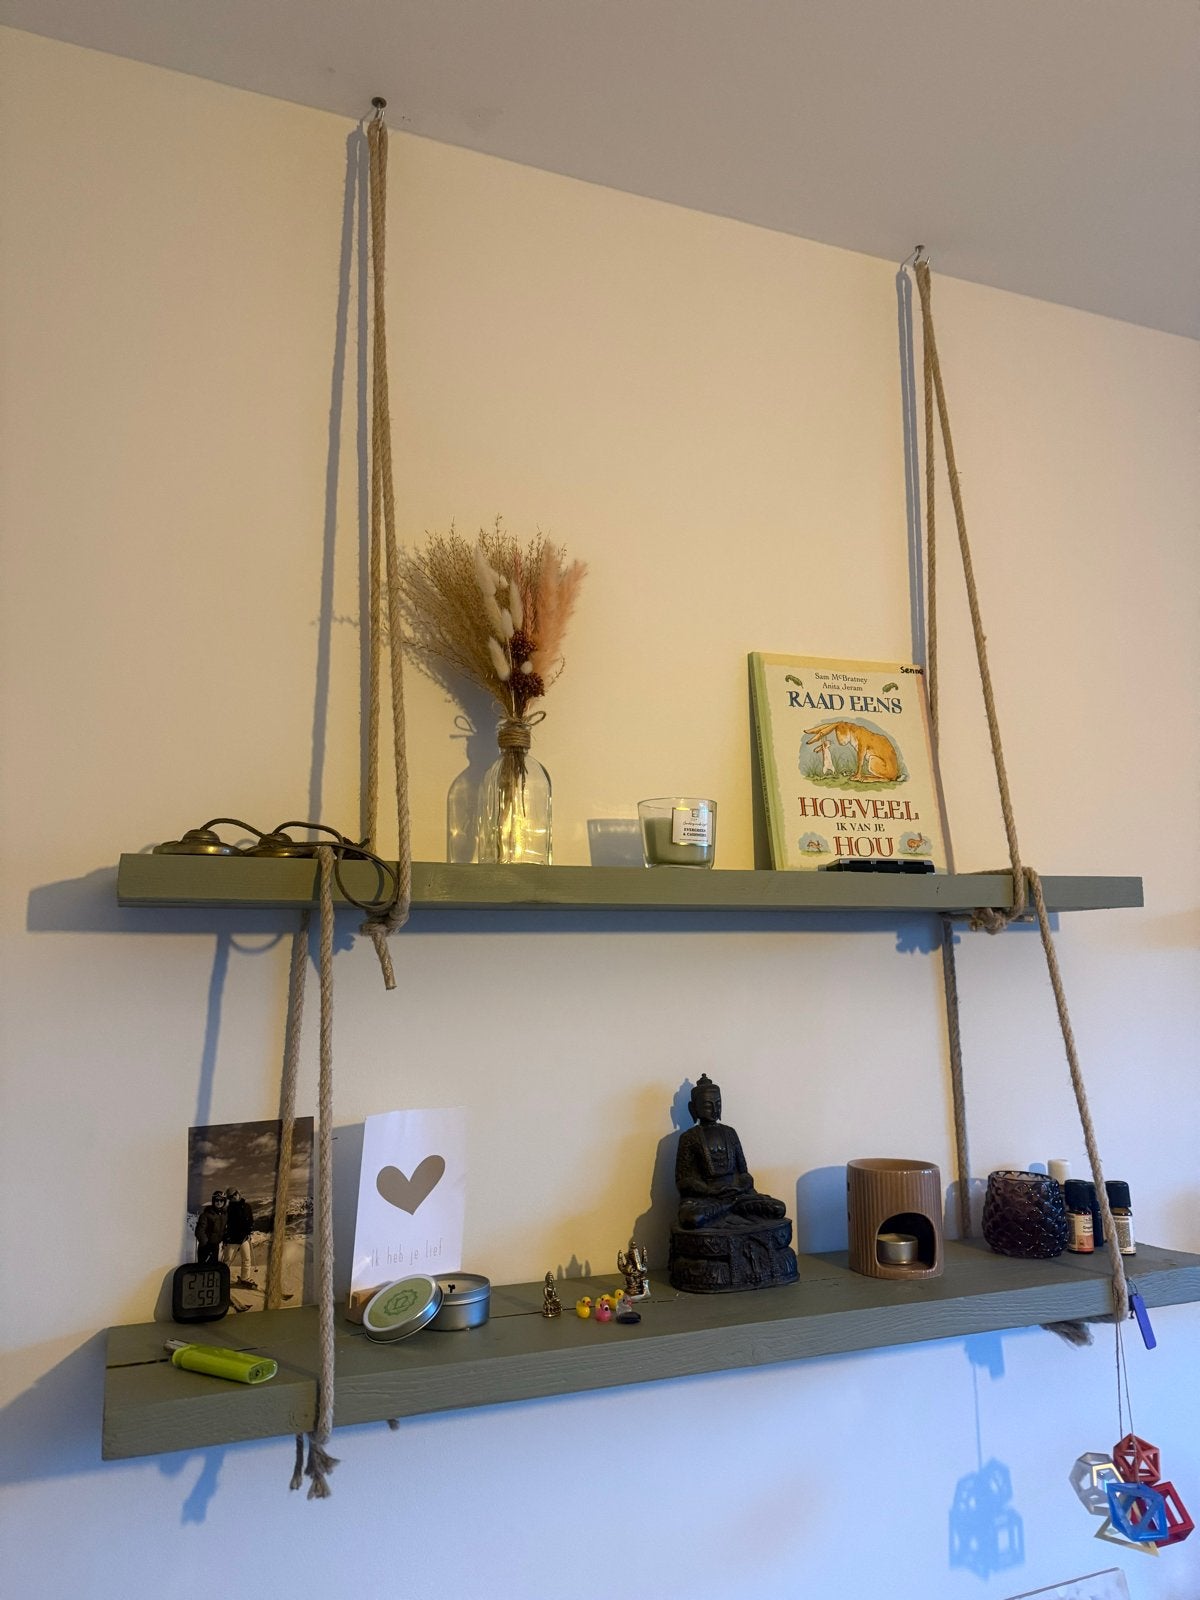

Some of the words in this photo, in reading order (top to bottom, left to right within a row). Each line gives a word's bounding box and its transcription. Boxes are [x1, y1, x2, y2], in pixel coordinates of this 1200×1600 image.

[814, 672, 830, 681] Sam
[831, 673, 868, 684] McBratney
[822, 682, 840, 690] Anita
[841, 682, 863, 692] Jeram
[786, 690, 845, 711] RAAD
[849, 695, 903, 714] EENS
[798, 796, 920, 822] HOEVEEL
[836, 822, 847, 832] IK
[849, 822, 871, 832] VAN
[874, 823, 886, 833] JE
[833, 836, 894, 858] HOU
[386, 1244, 404, 1265] heb
[409, 1248, 420, 1266] je
[425, 1237, 443, 1259] lief
[197, 1289, 214, 1306] 59
